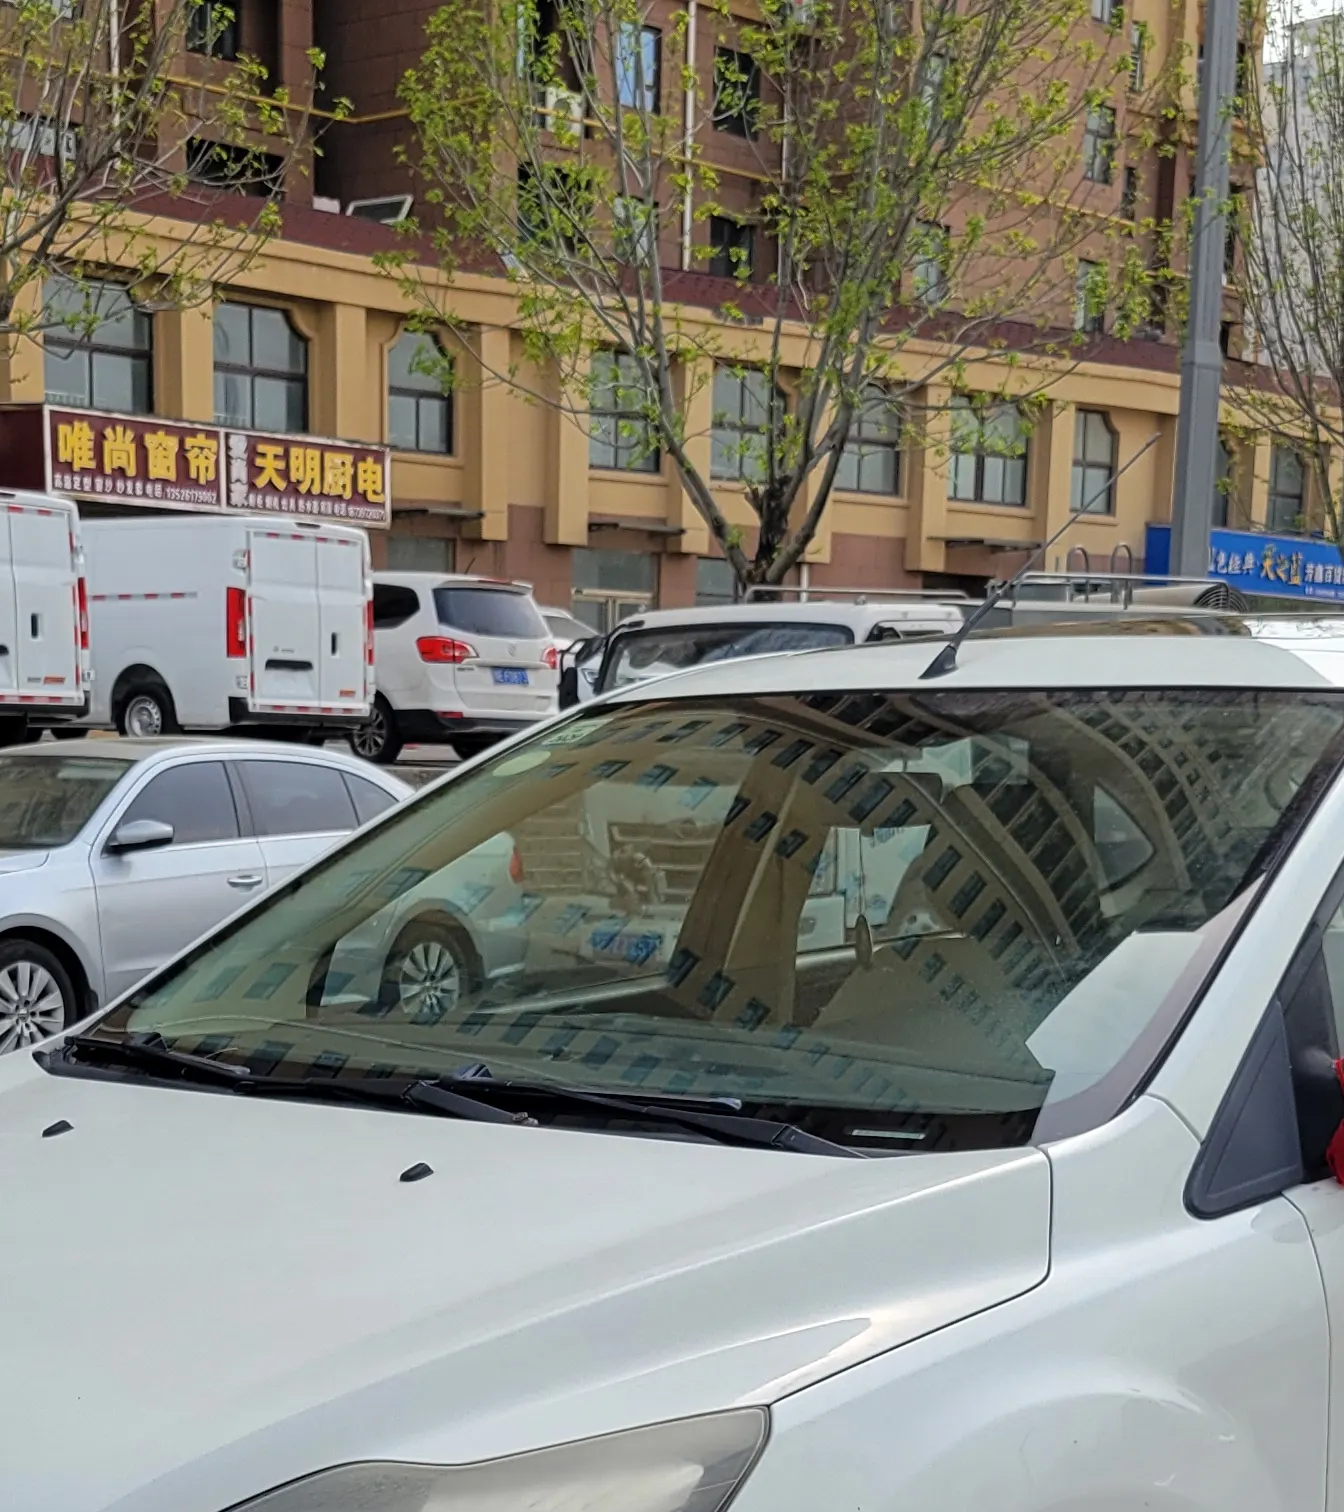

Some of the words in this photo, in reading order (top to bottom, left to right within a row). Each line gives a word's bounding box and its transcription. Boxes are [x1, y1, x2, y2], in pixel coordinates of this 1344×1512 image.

[58, 420, 218, 485] 唯尚窗帘
[253, 443, 385, 503] 天明厨电
